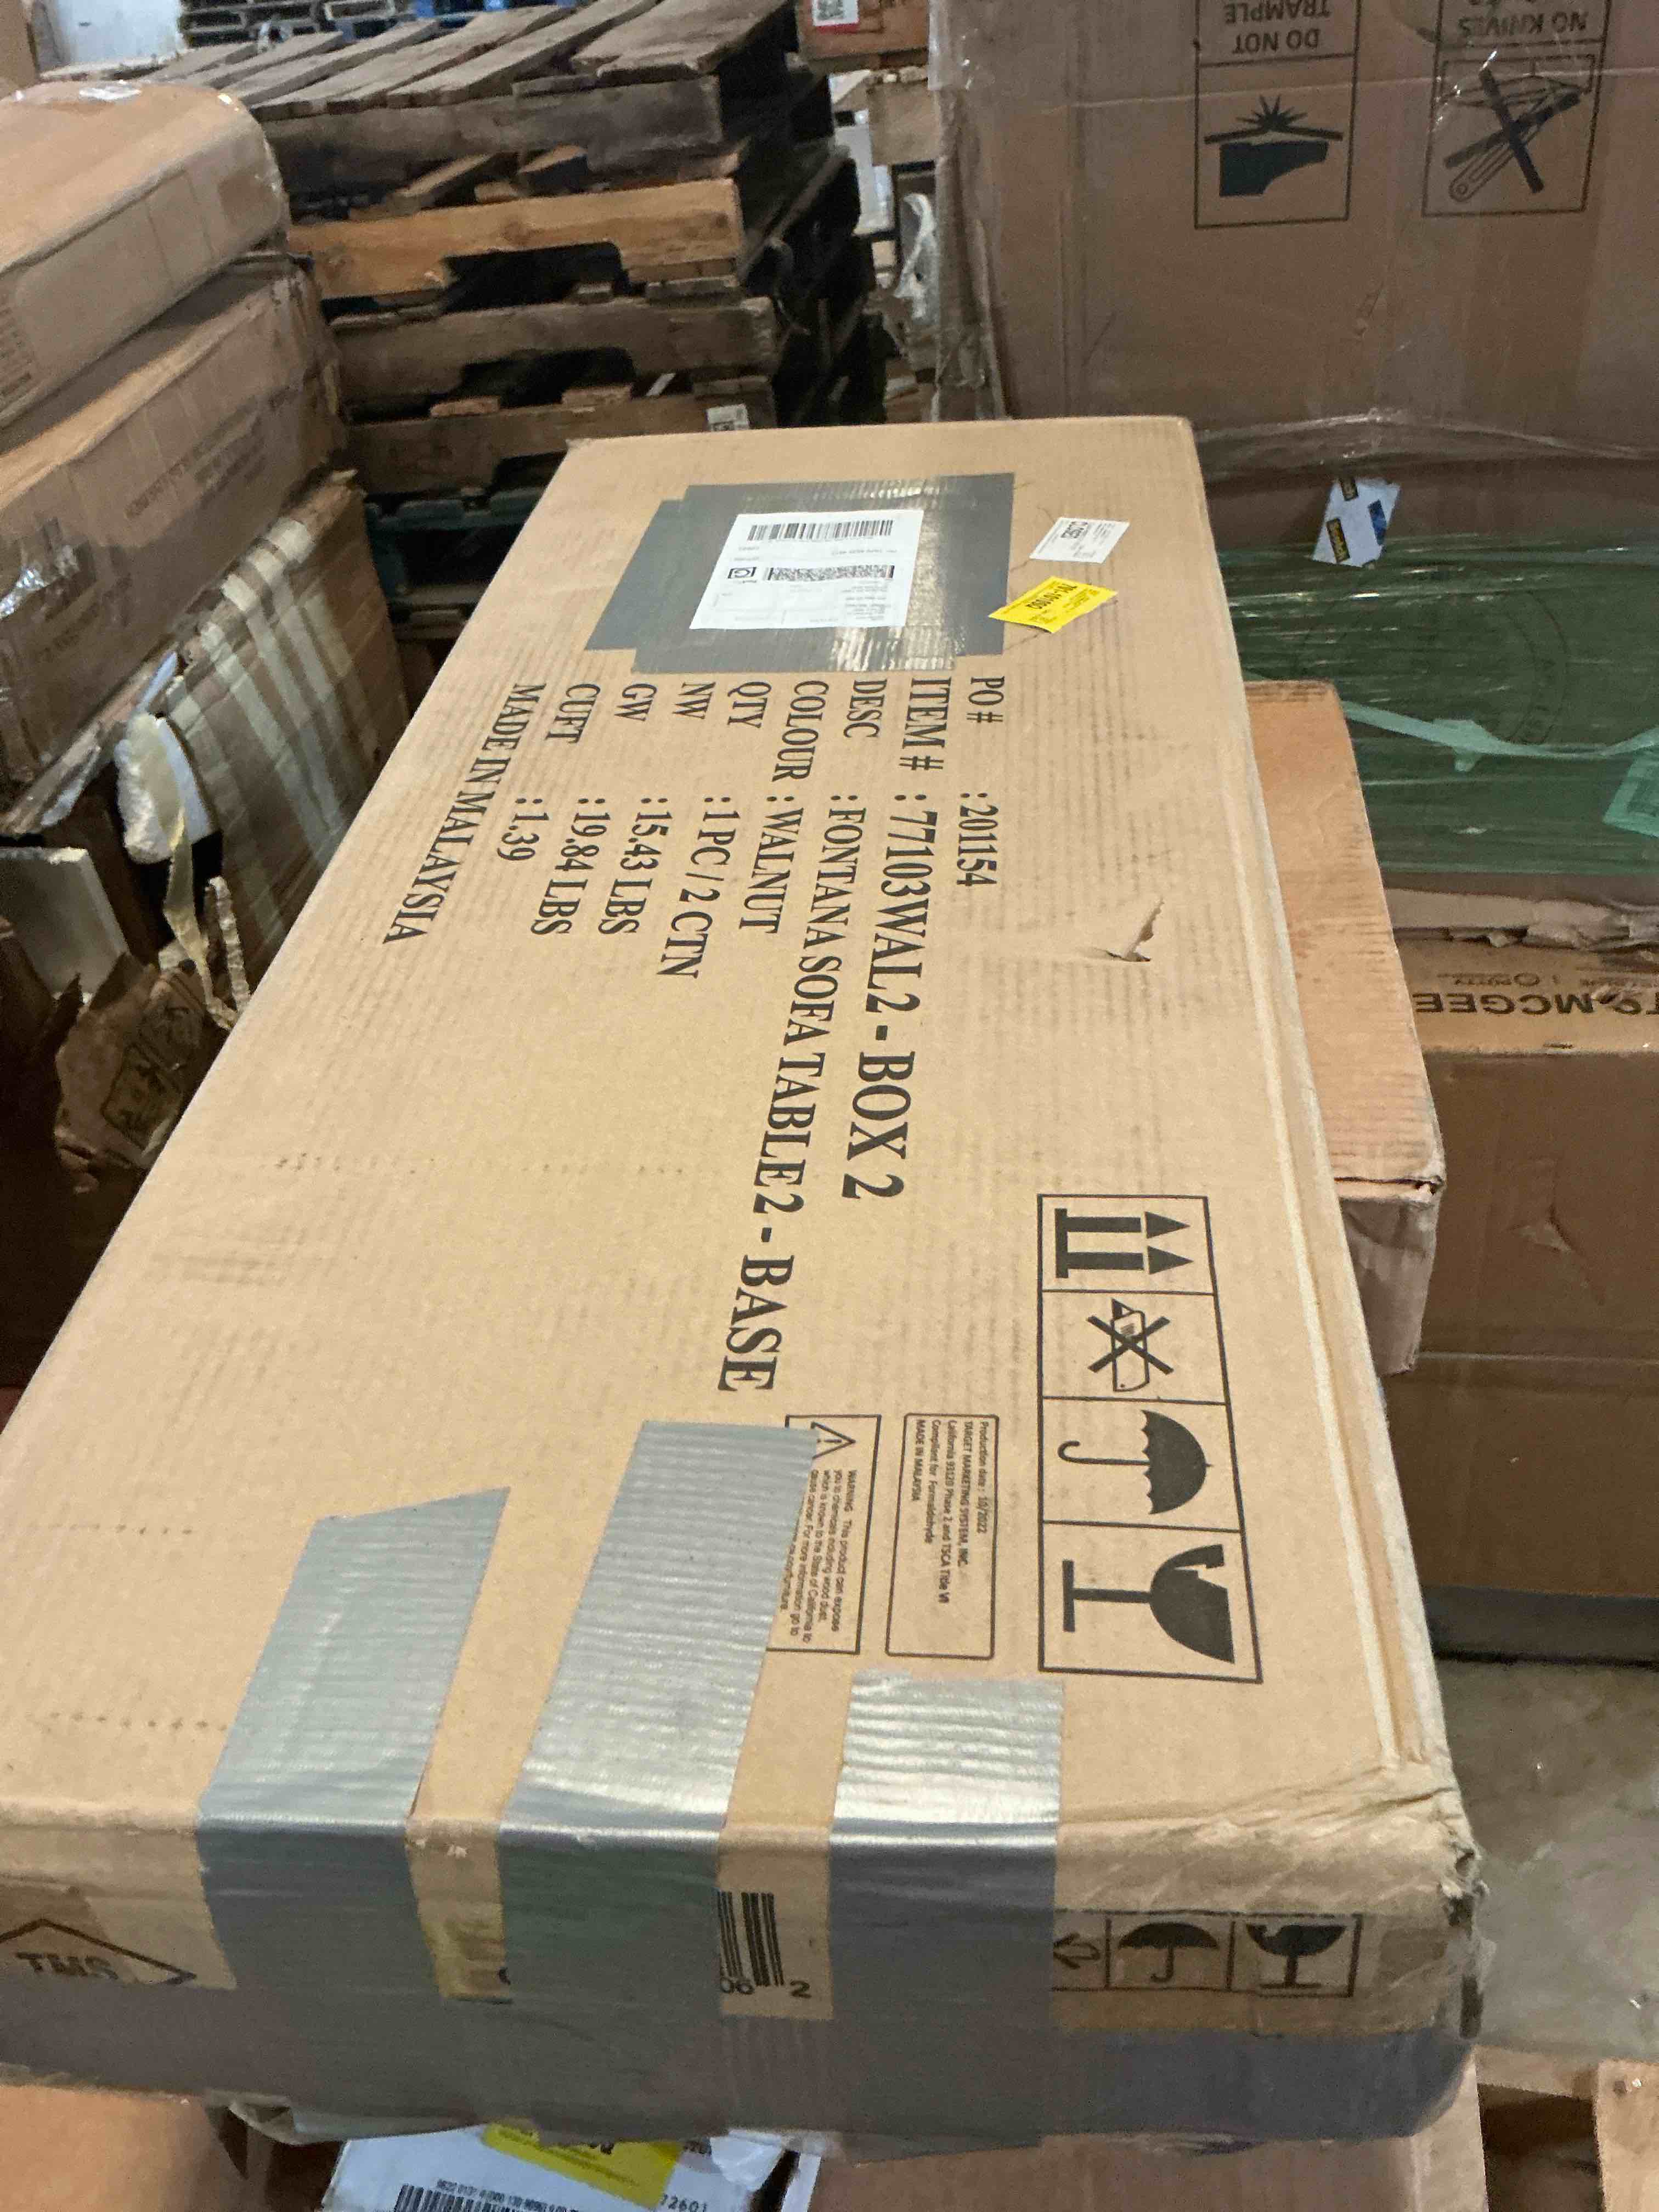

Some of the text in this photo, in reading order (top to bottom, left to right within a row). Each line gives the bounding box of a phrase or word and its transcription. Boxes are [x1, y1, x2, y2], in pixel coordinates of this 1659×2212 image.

[1224, 0, 1331, 25] TRAMPLE
[1551, 12, 1589, 33] NO
[1233, 29, 1321, 54] DO NOT
[614, 684, 657, 721] GW
[673, 682, 716, 720] NW
[727, 681, 772, 729] QTY
[843, 679, 888, 738] DESC
[968, 675, 1005, 706] PO
[545, 684, 601, 744] CUFT
[771, 680, 830, 782] COLOUR
[902, 677, 952, 749] ITEM
[382, 683, 546, 944] MADE IN MALAYSIA
[702, 811, 740, 821] 1
[496, 812, 549, 861] 1.39
[555, 812, 611, 872] 19.84
[620, 811, 673, 871] 15.43
[690, 829, 736, 865] PC
[956, 805, 999, 887] 201154
[739, 807, 804, 934] WALNUT
[803, 808, 866, 950] FONTANA
[531, 879, 589, 935] LBS
[598, 878, 653, 934] LBS
[679, 888, 720, 902] 2
[865, 811, 938, 1013] 77103WAL2
[656, 911, 713, 979] CTN
[783, 956, 842, 1046] SOFA
[1412, 992, 1593, 1014] MCGEE
[847, 1051, 916, 1161] BOX
[842, 1173, 904, 1199] 2
[718, 1255, 795, 1392] BASE
[930, 1420, 940, 1462] Compliant
[946, 1420, 957, 1458] California
[963, 1421, 973, 1452] TARGET
[979, 1421, 989, 1466] Production
[912, 1420, 925, 1501] MADE IN MALAYSIA
[929, 1464, 939, 1475] for
[961, 1454, 972, 1505] MARKETING
[817, 1502, 826, 1527] known
[828, 1495, 840, 1535] chemicals
[943, 1489, 954, 1514] Phase
[803, 1525, 813, 1538] For
[814, 1541, 823, 1553] the
[842, 1520, 852, 1538] This
[943, 1525, 951, 1541] and
[799, 1541, 809, 1561] more
[811, 1555, 822, 1577] State
[823, 1538, 835, 1573] including
[836, 1541, 848, 1574] product
[940, 1544, 951, 1567] TSCA
[794, 1564, 807, 1611] information
[821, 1577, 831, 1599] wood
[836, 1577, 844, 1594] can
[939, 1569, 951, 1590] Title
[790, 1613, 800, 1625] go
[804, 1589, 819, 1631] California
[831, 1596, 843, 1632] expose
[790, 1980, 812, 1999] 2
